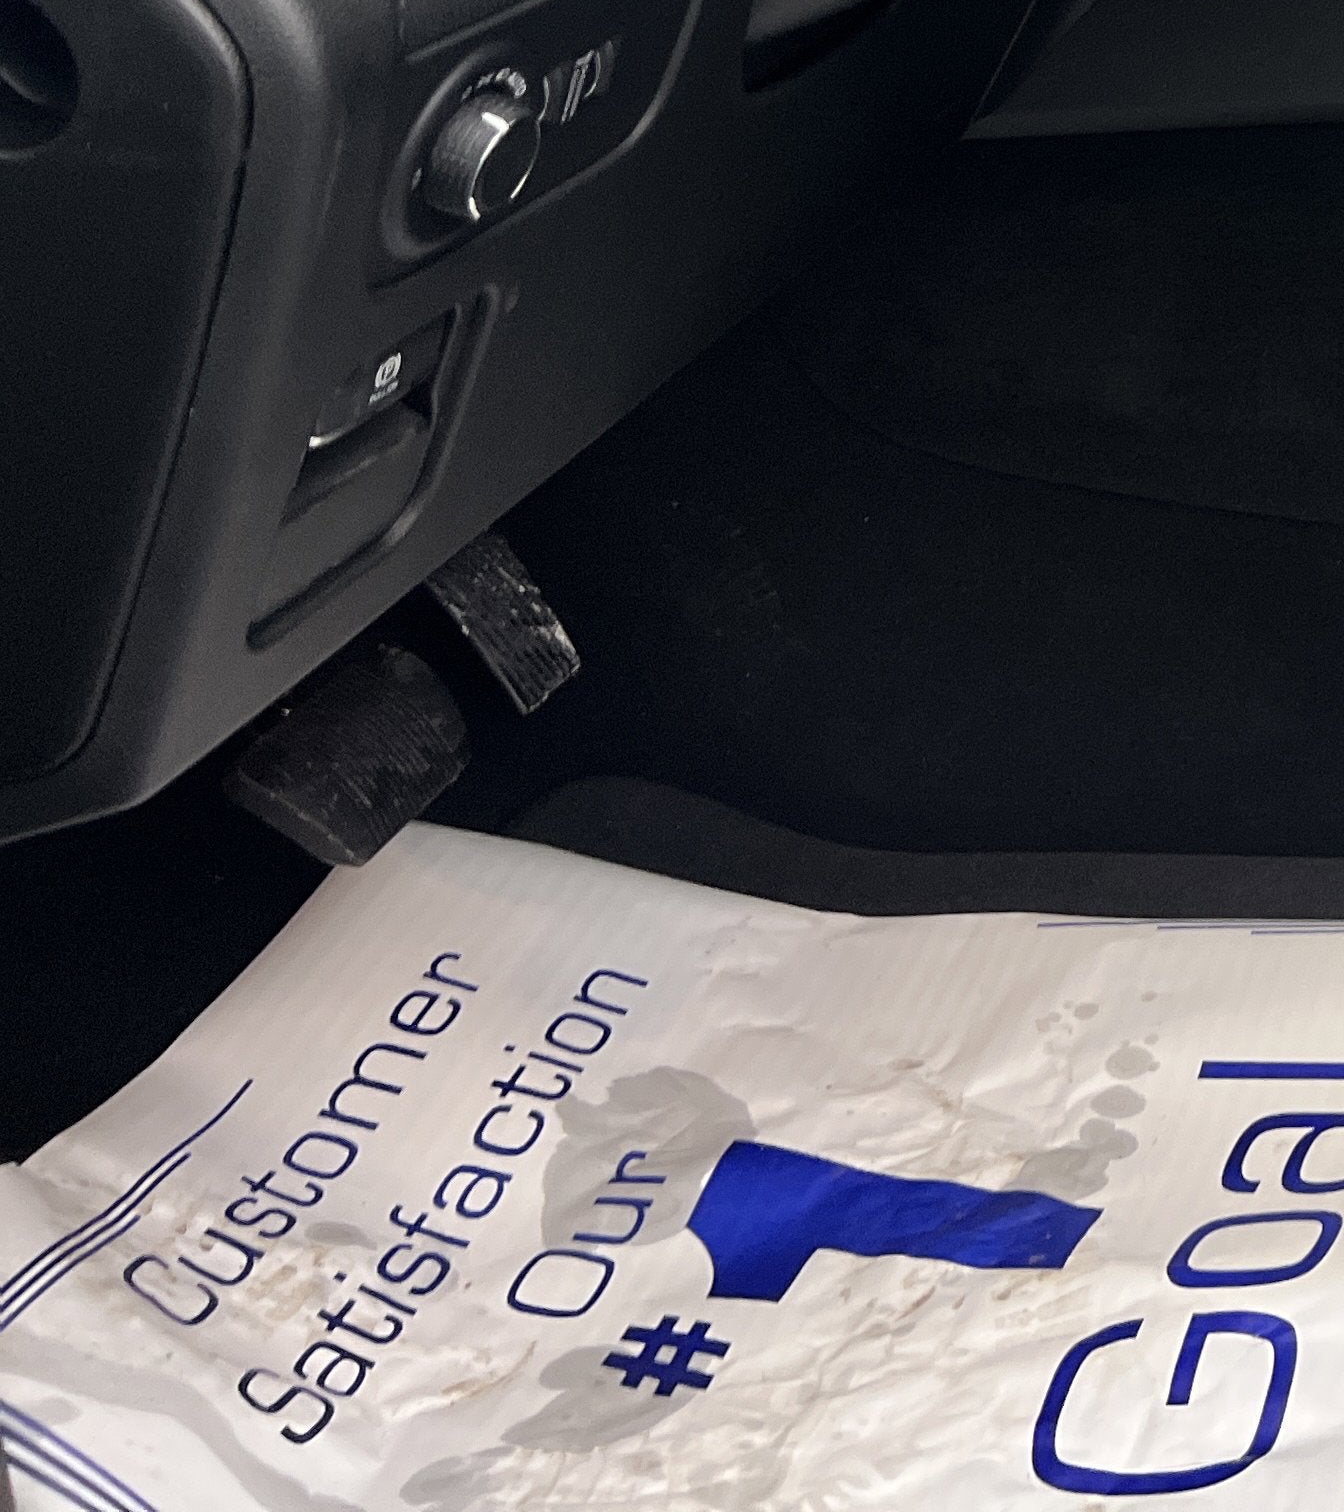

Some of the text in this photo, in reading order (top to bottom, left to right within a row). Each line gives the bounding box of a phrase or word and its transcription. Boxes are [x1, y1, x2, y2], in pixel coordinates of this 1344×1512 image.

[123, 951, 479, 1326] Customer
[237, 968, 648, 1445] Satisfaction
[506, 1149, 668, 1318] Our
